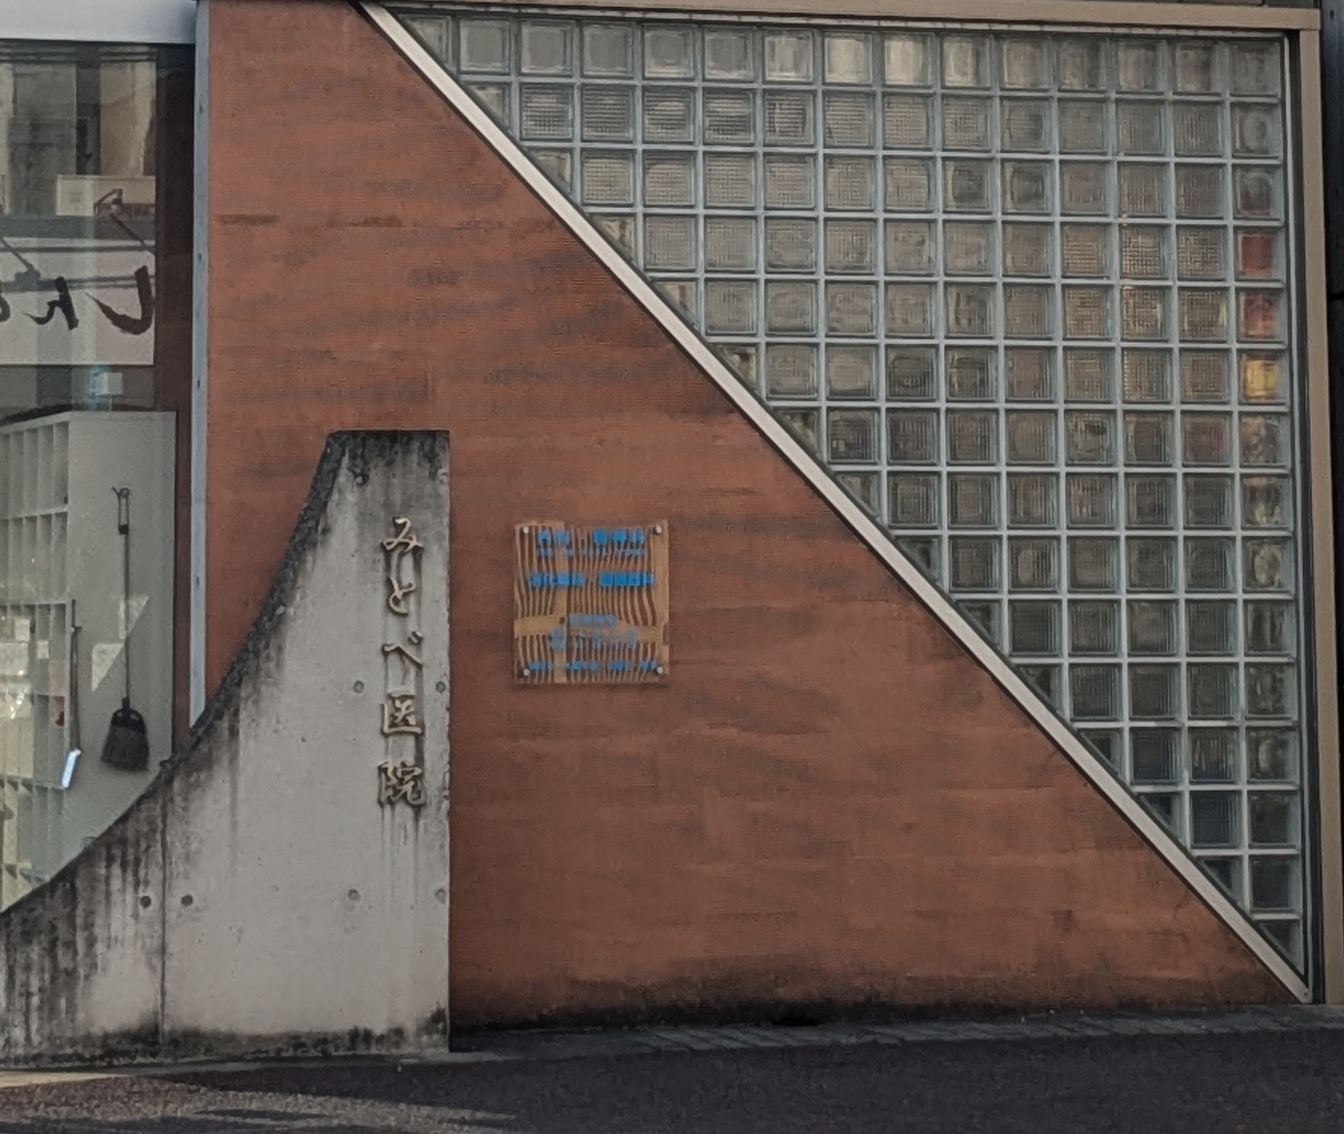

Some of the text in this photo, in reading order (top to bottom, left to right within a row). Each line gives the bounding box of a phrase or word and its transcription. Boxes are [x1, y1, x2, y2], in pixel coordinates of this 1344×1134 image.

[378, 516, 427, 806] みとべ医院
